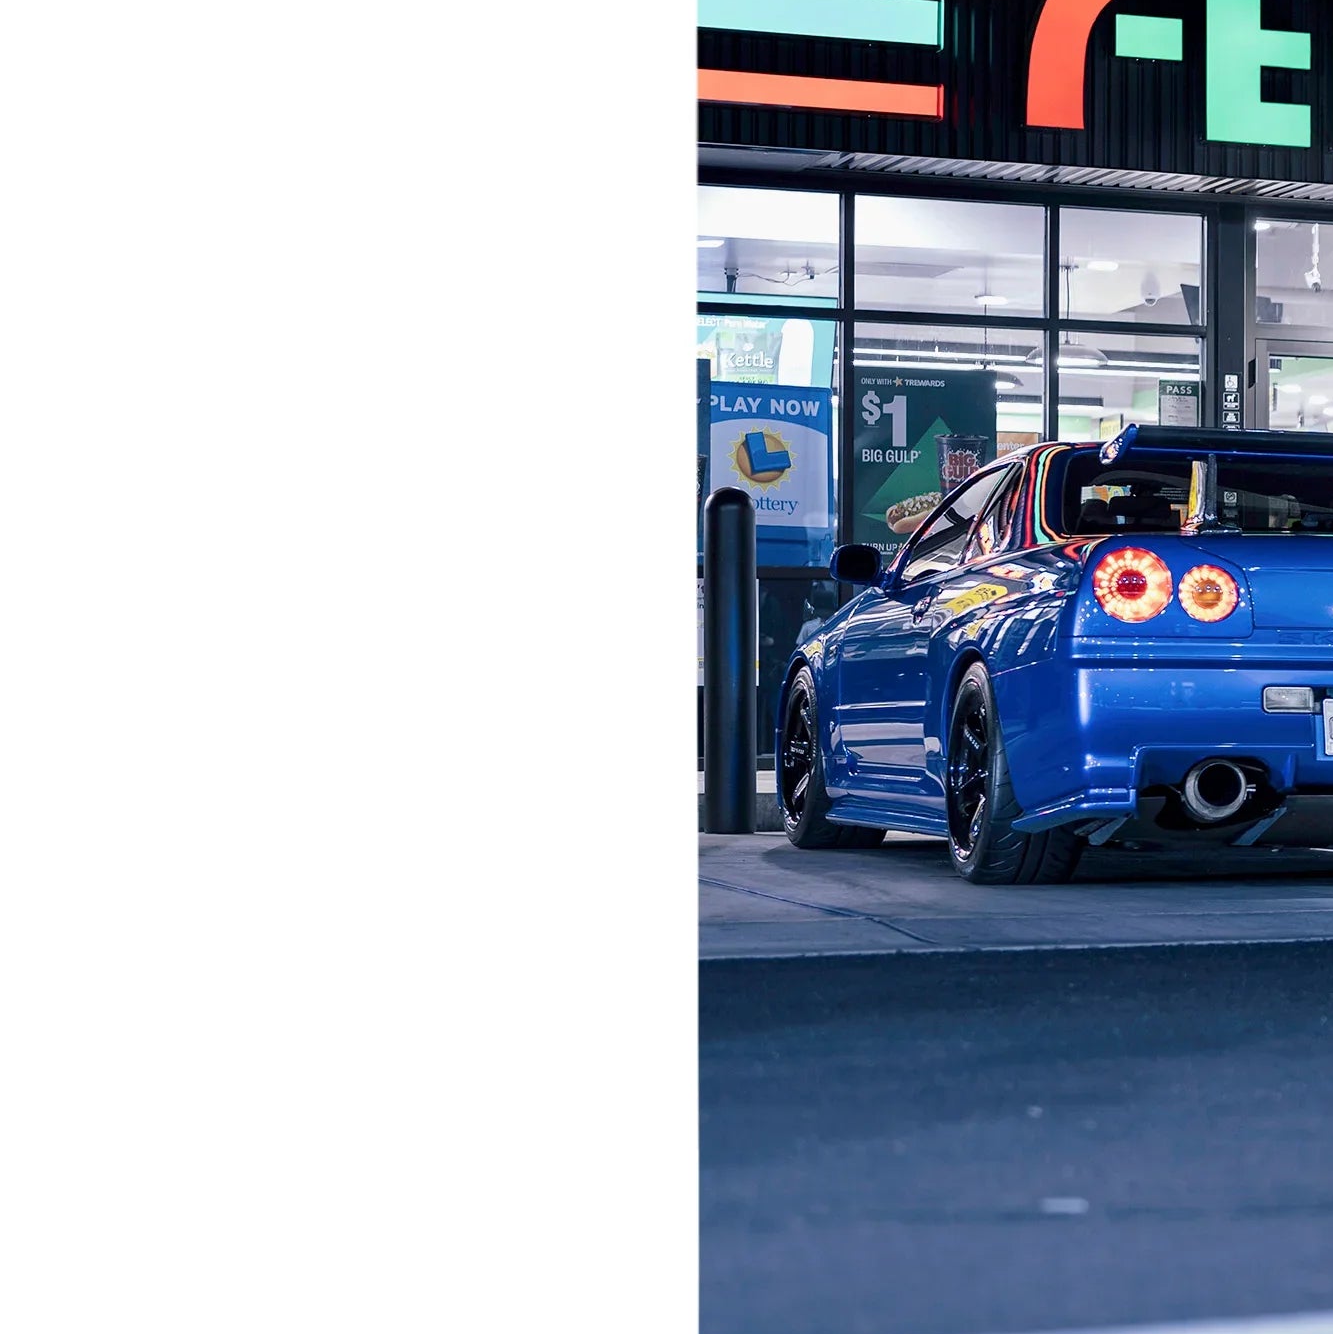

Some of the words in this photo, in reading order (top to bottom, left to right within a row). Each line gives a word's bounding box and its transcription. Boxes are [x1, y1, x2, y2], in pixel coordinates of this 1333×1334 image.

[726, 350, 775, 369] Kettle
[860, 377, 875, 385] ONLY
[876, 378, 892, 386] WITH
[1166, 385, 1193, 395] PASS
[710, 395, 762, 414] PLAY
[770, 399, 820, 417] NOW
[861, 390, 907, 448] $1
[862, 448, 883, 463] BIG
[887, 449, 919, 464] GULP
[751, 496, 799, 516] ottery
